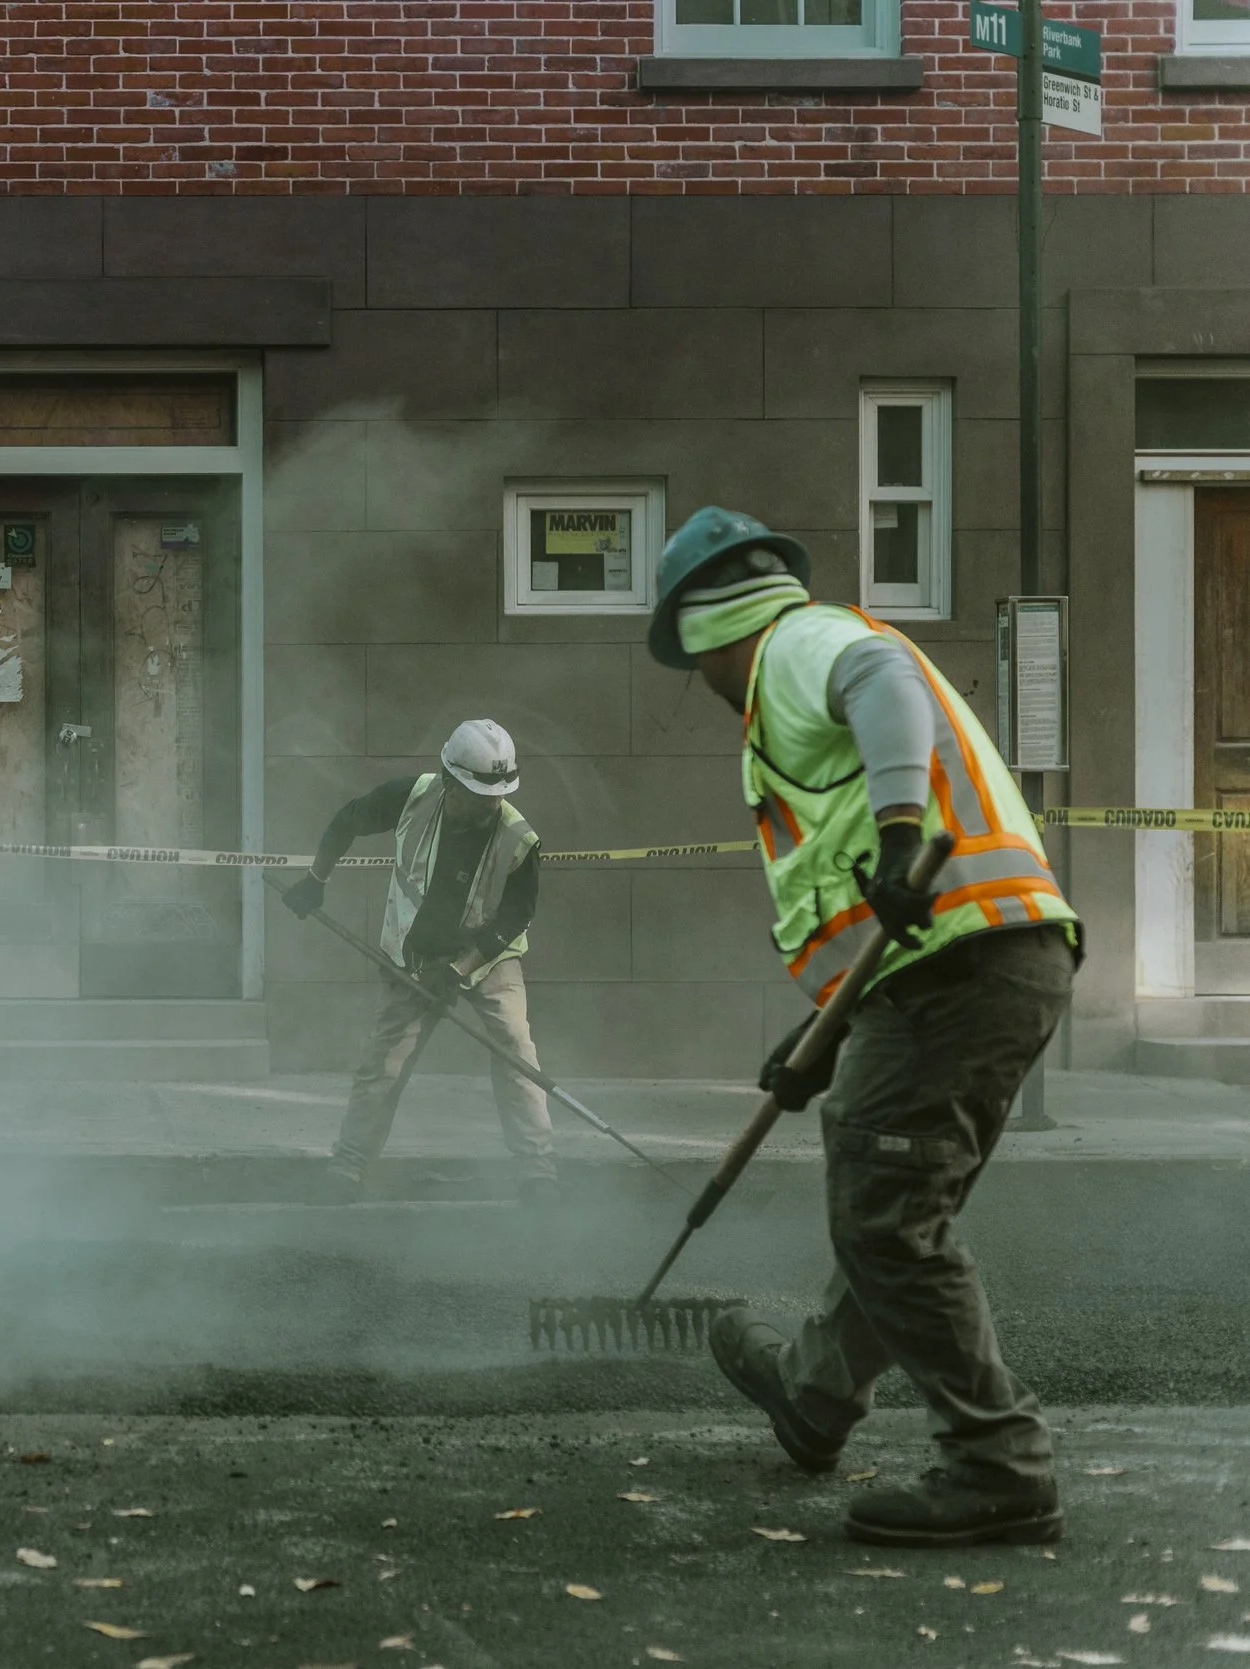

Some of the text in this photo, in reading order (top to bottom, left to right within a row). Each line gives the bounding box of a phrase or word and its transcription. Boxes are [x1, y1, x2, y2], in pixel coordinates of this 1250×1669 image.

[975, 12, 1007, 46] M11
[1043, 26, 1082, 48] Riverbank
[1043, 43, 1061, 60] Park
[1043, 76, 1099, 101] Greenwich St &
[1044, 94, 1080, 113] Horatio St
[550, 514, 616, 531] MARVIN
